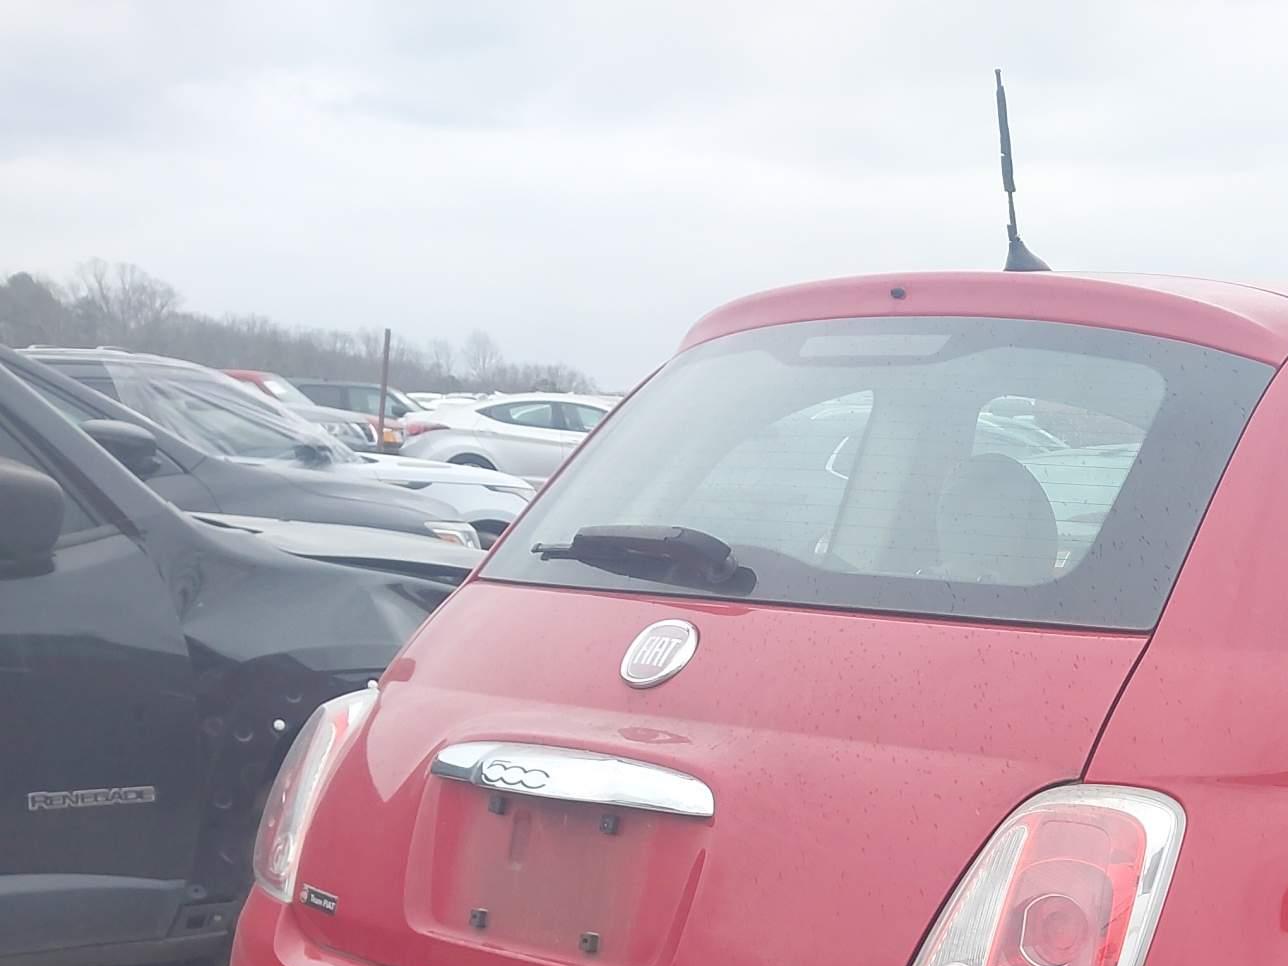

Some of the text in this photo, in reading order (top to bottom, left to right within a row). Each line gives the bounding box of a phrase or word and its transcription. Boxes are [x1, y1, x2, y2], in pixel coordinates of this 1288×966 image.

[632, 635, 682, 668] FIAT
[481, 759, 550, 789] 500
[28, 785, 156, 811] RENEGADE
